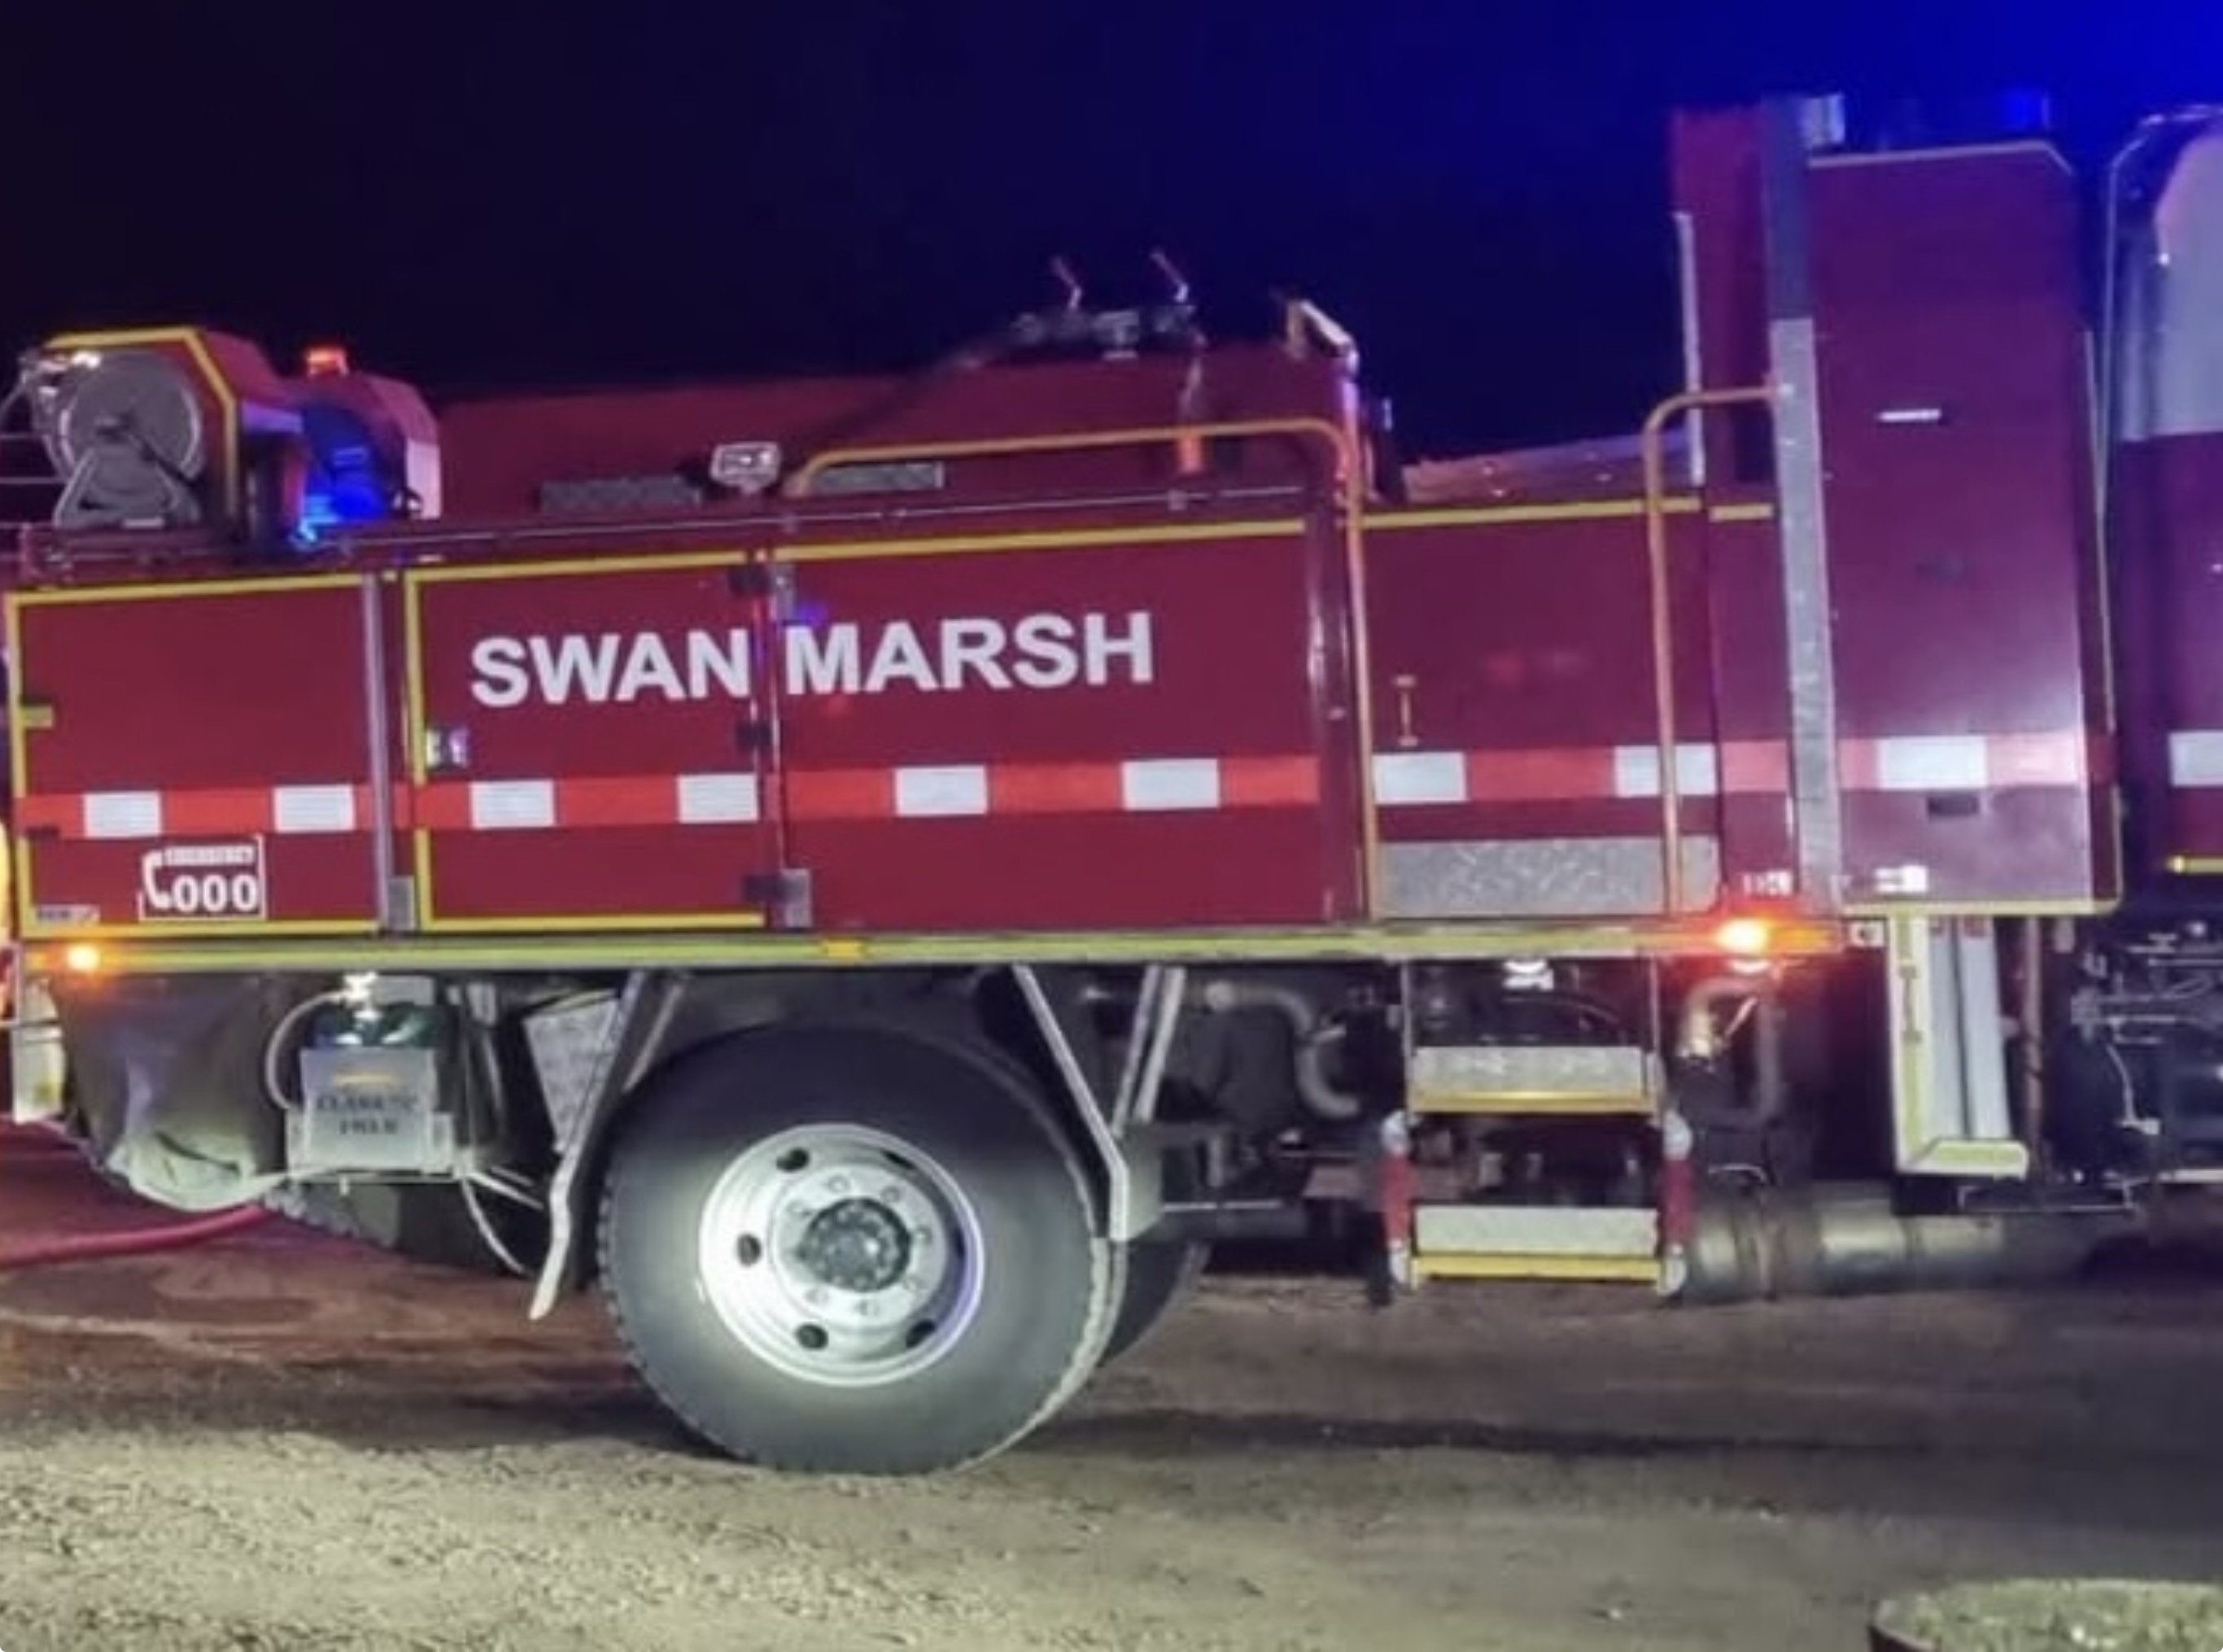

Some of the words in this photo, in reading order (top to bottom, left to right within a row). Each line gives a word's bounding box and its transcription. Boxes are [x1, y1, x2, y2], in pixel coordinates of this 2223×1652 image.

[471, 627, 749, 707] SWAN
[785, 611, 1152, 695] MARSH
[173, 874, 258, 912] 000
